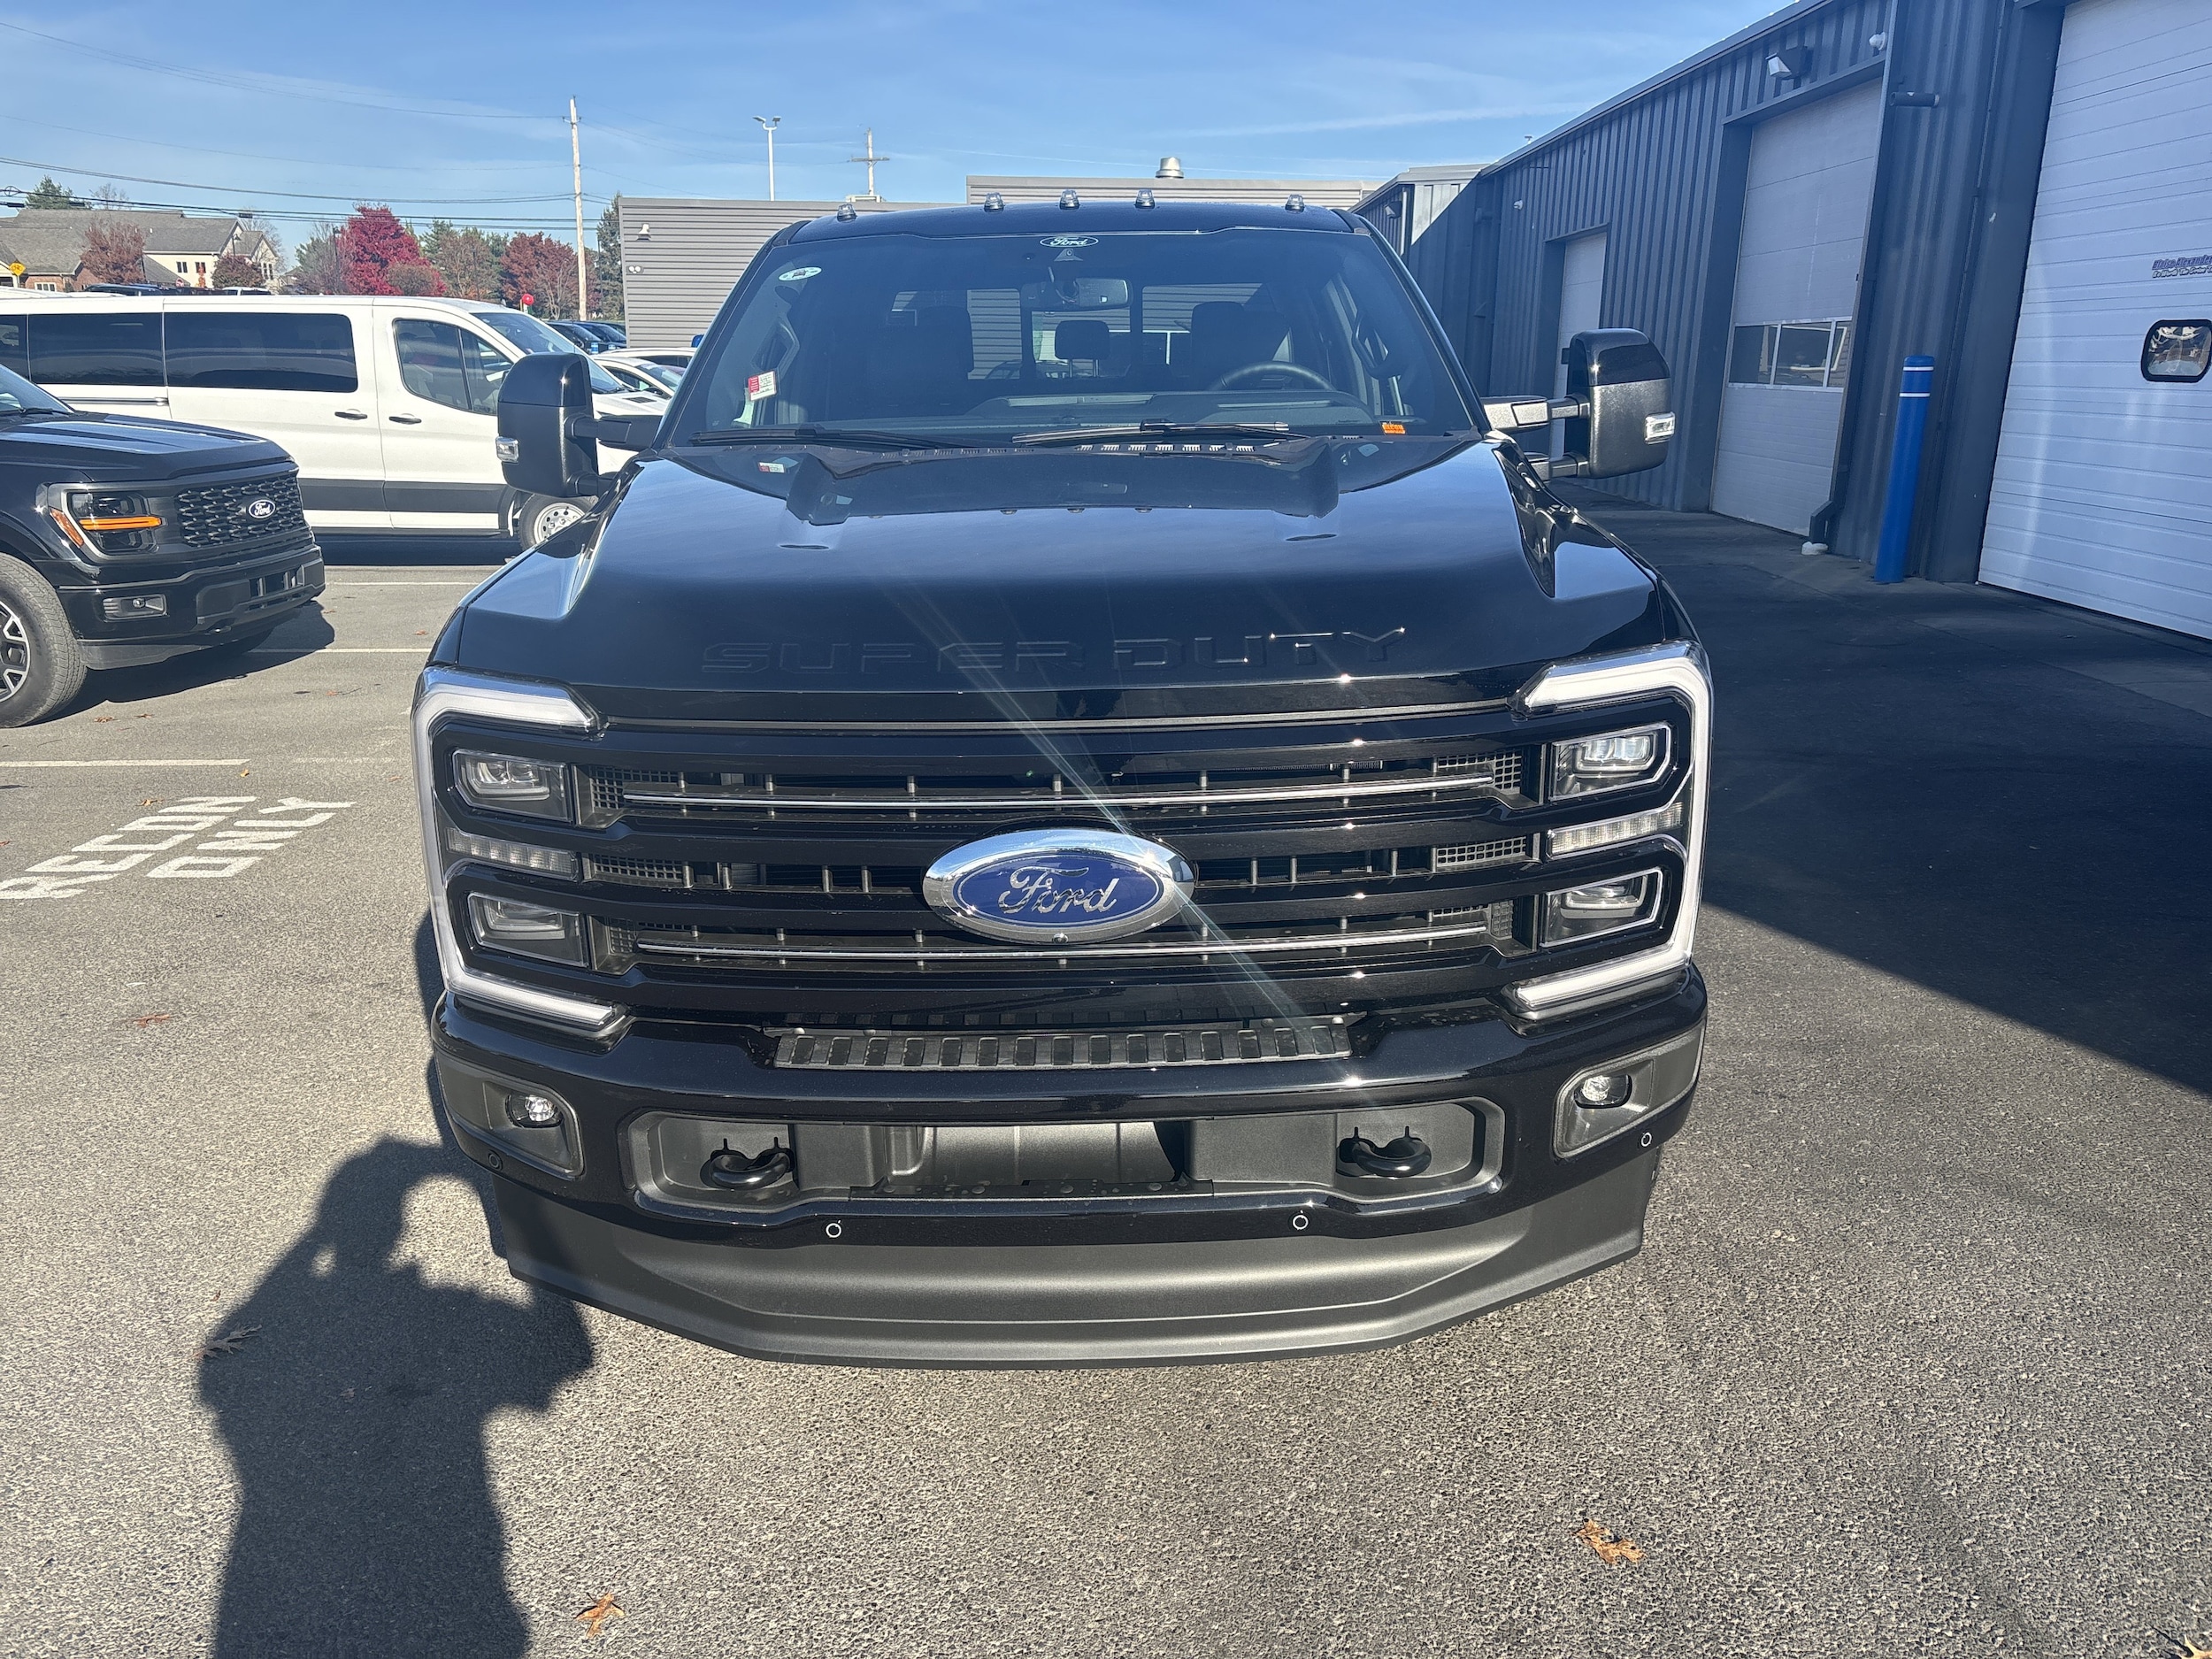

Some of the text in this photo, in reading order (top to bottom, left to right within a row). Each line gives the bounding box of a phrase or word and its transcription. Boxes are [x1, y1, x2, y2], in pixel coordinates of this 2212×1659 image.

[1049, 236, 1088, 247] Ford
[254, 503, 271, 515] Ford
[702, 627, 1405, 674] SUPER DUTY
[0, 796, 258, 899] RECON
[145, 796, 357, 878] ONLY
[998, 866, 1120, 914] Ford
